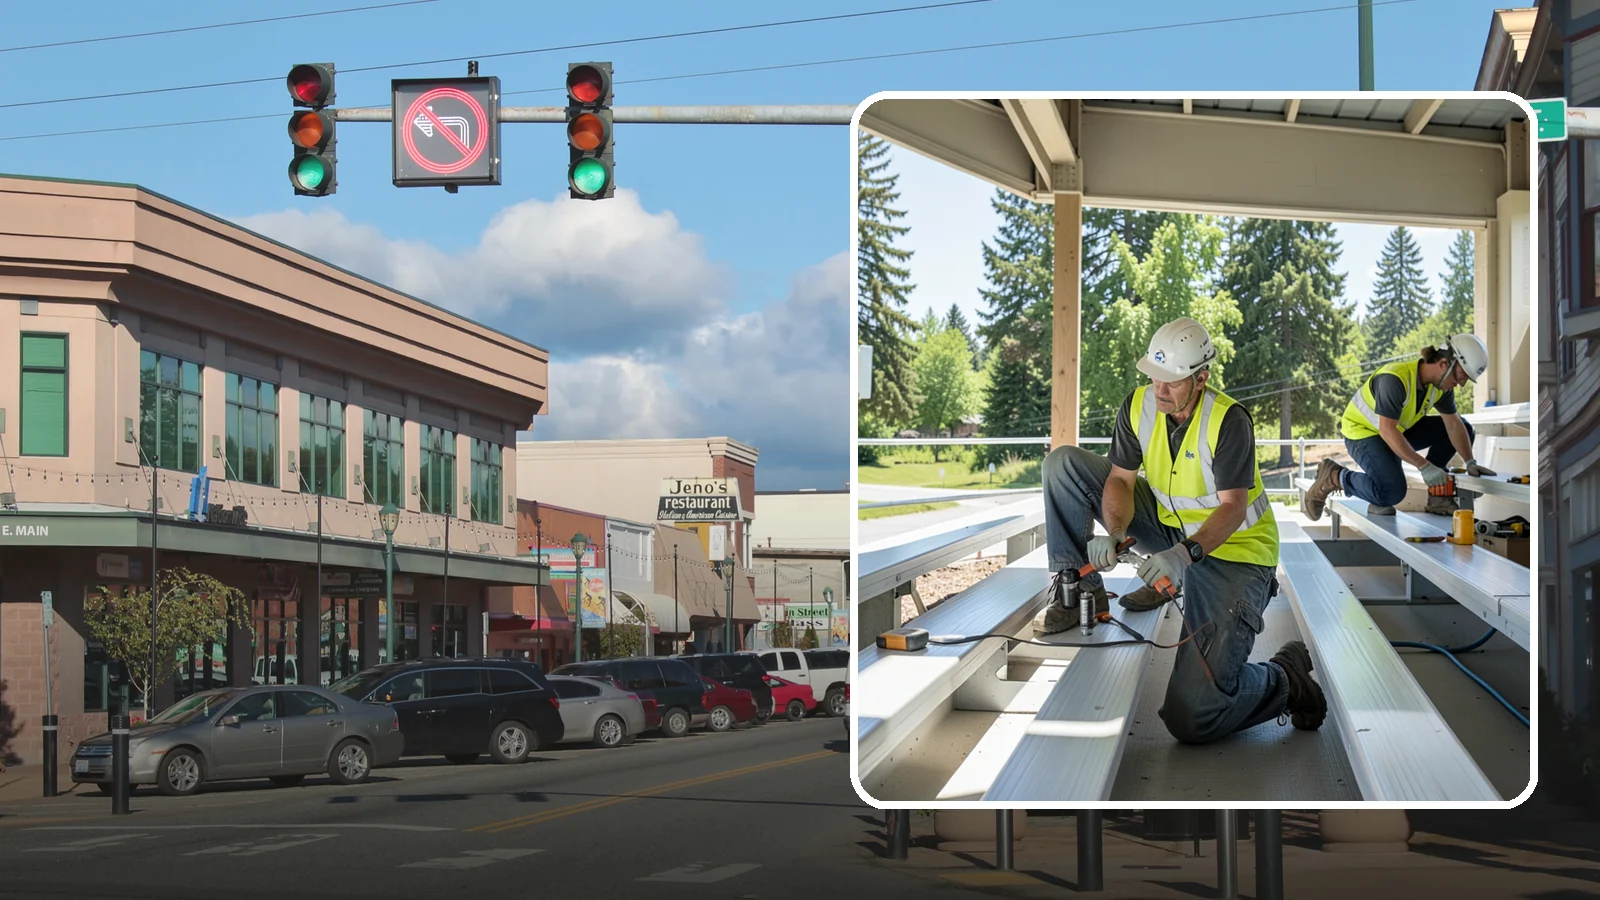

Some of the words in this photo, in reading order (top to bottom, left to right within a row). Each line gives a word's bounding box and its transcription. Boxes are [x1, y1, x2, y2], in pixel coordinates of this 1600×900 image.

[670, 480, 727, 494] Jeno's
[665, 496, 731, 509] restaurant
[686, 510, 715, 519] American
[715, 509, 737, 519] Cuisine
[2, 525, 13, 536] E.
[15, 525, 49, 536] MAIN
[797, 607, 829, 617] Street
